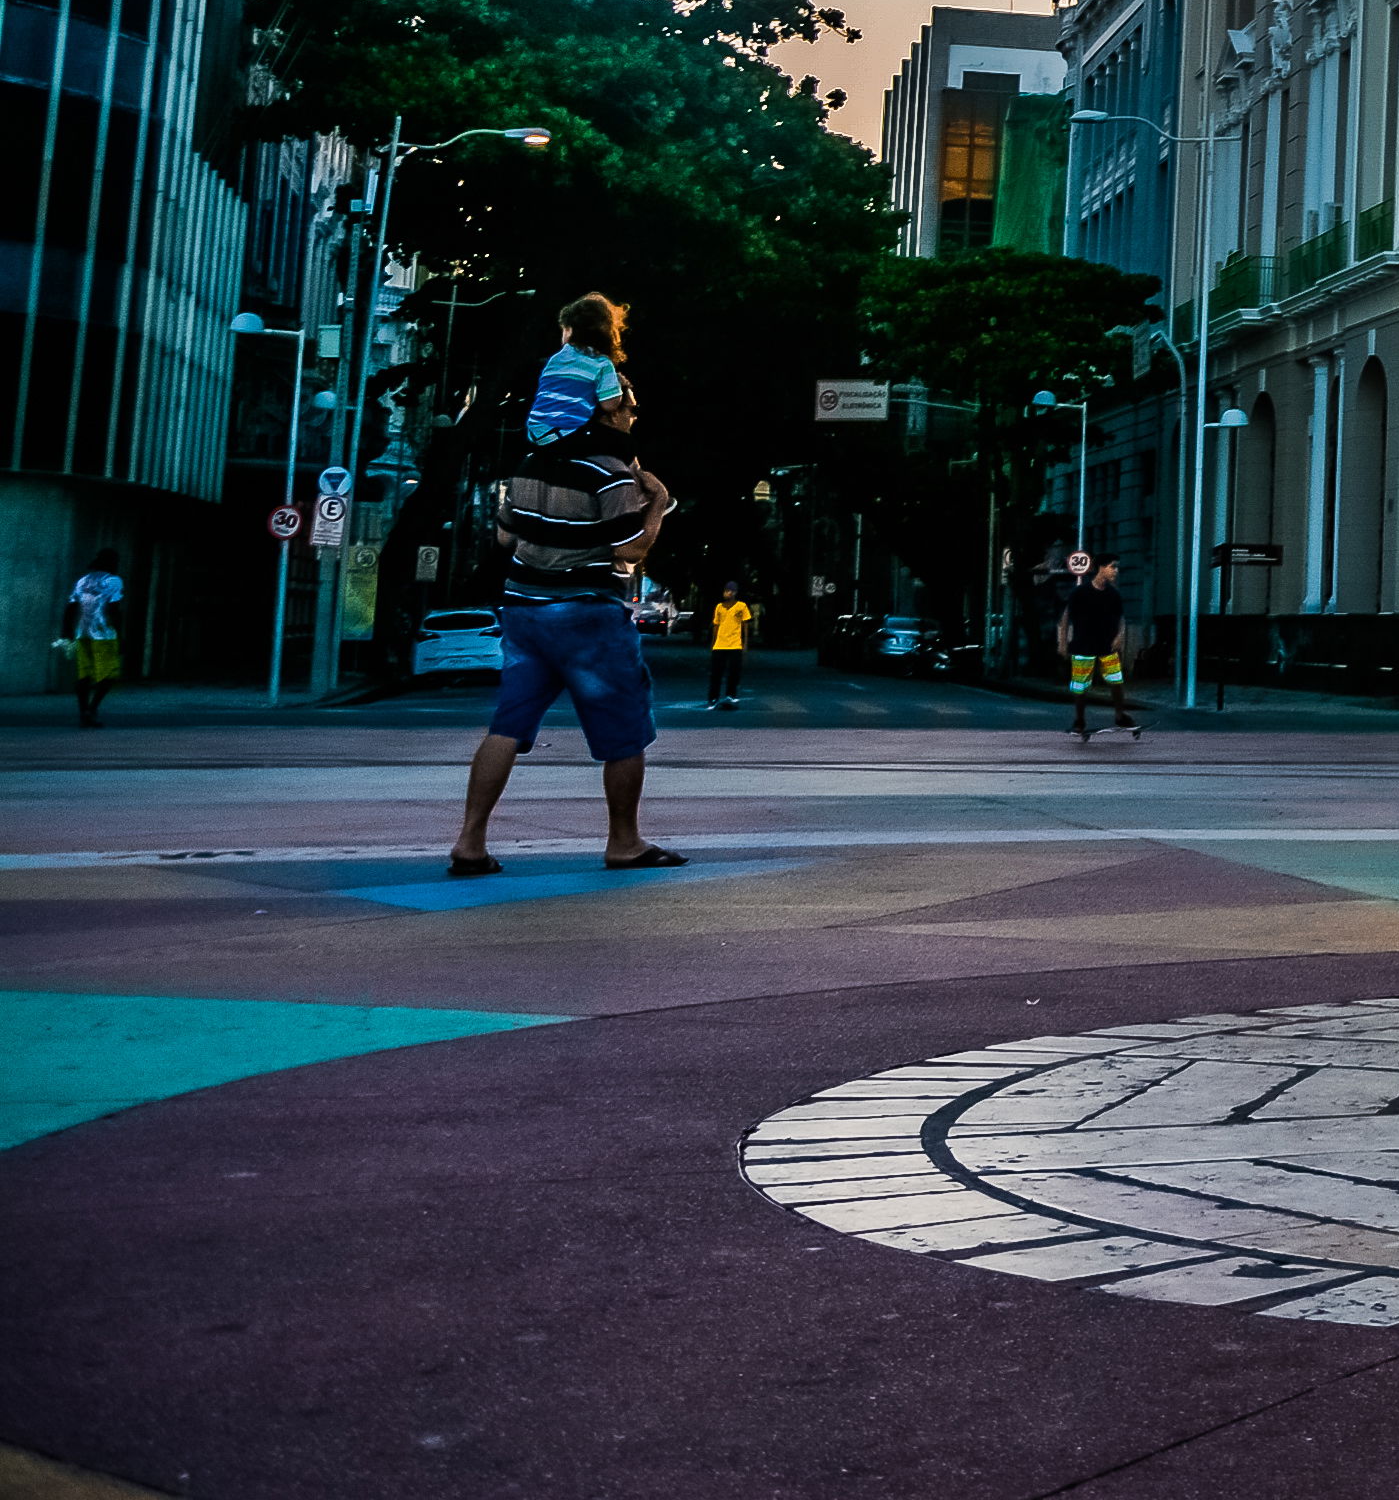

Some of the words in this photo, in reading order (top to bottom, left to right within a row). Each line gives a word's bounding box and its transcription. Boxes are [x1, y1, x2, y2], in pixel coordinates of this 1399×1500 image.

[326, 501, 339, 516] E
[273, 511, 298, 529] 30
[1071, 555, 1089, 567] 30
